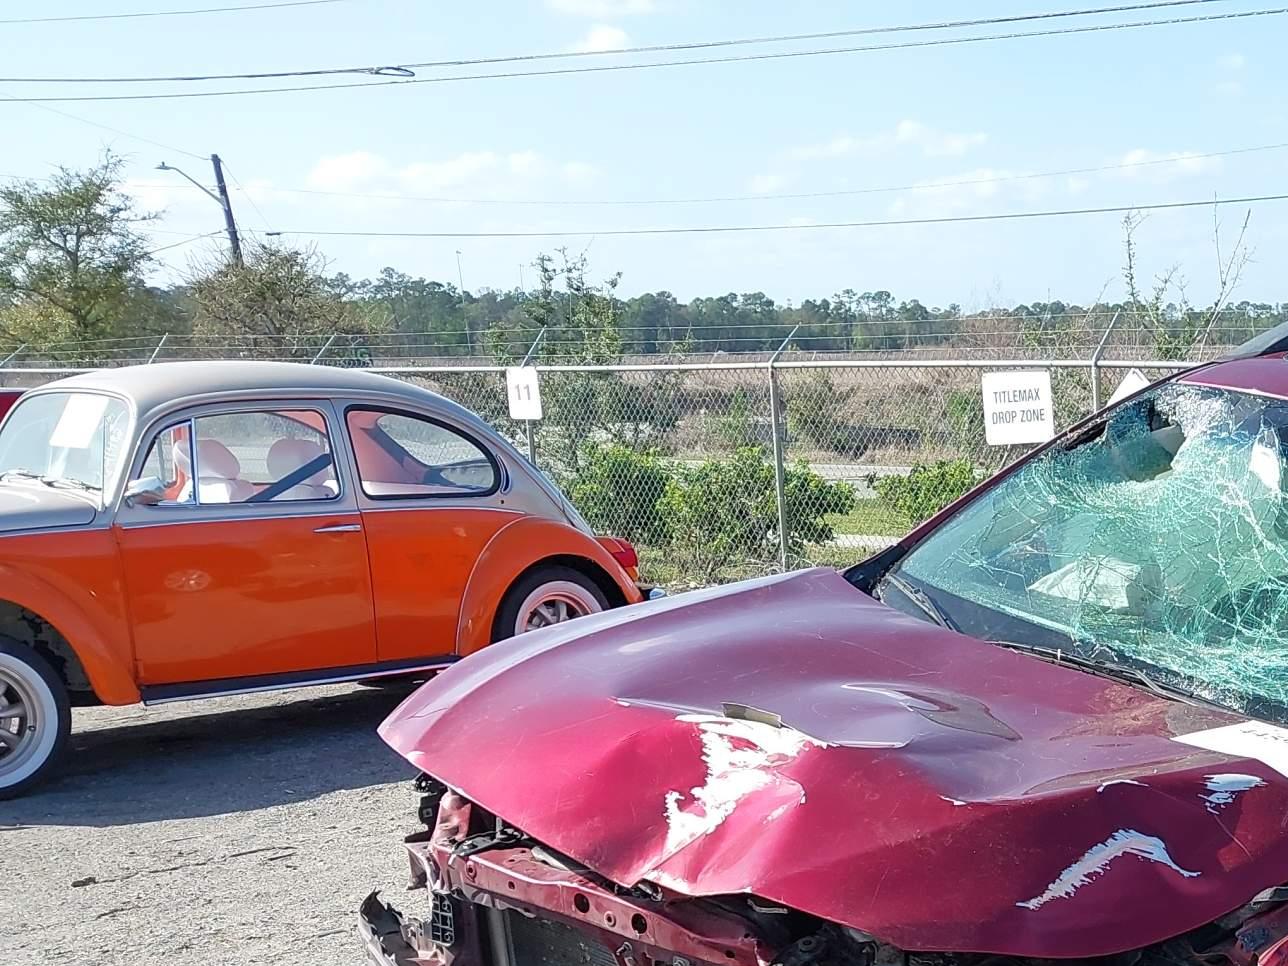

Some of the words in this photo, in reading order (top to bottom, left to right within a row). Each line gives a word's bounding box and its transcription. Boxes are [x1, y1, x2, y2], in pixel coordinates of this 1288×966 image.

[514, 383, 531, 401] 11
[993, 388, 1041, 404] TITLEMAX
[992, 410, 1017, 425] DROP
[1020, 409, 1045, 423] ZONE
